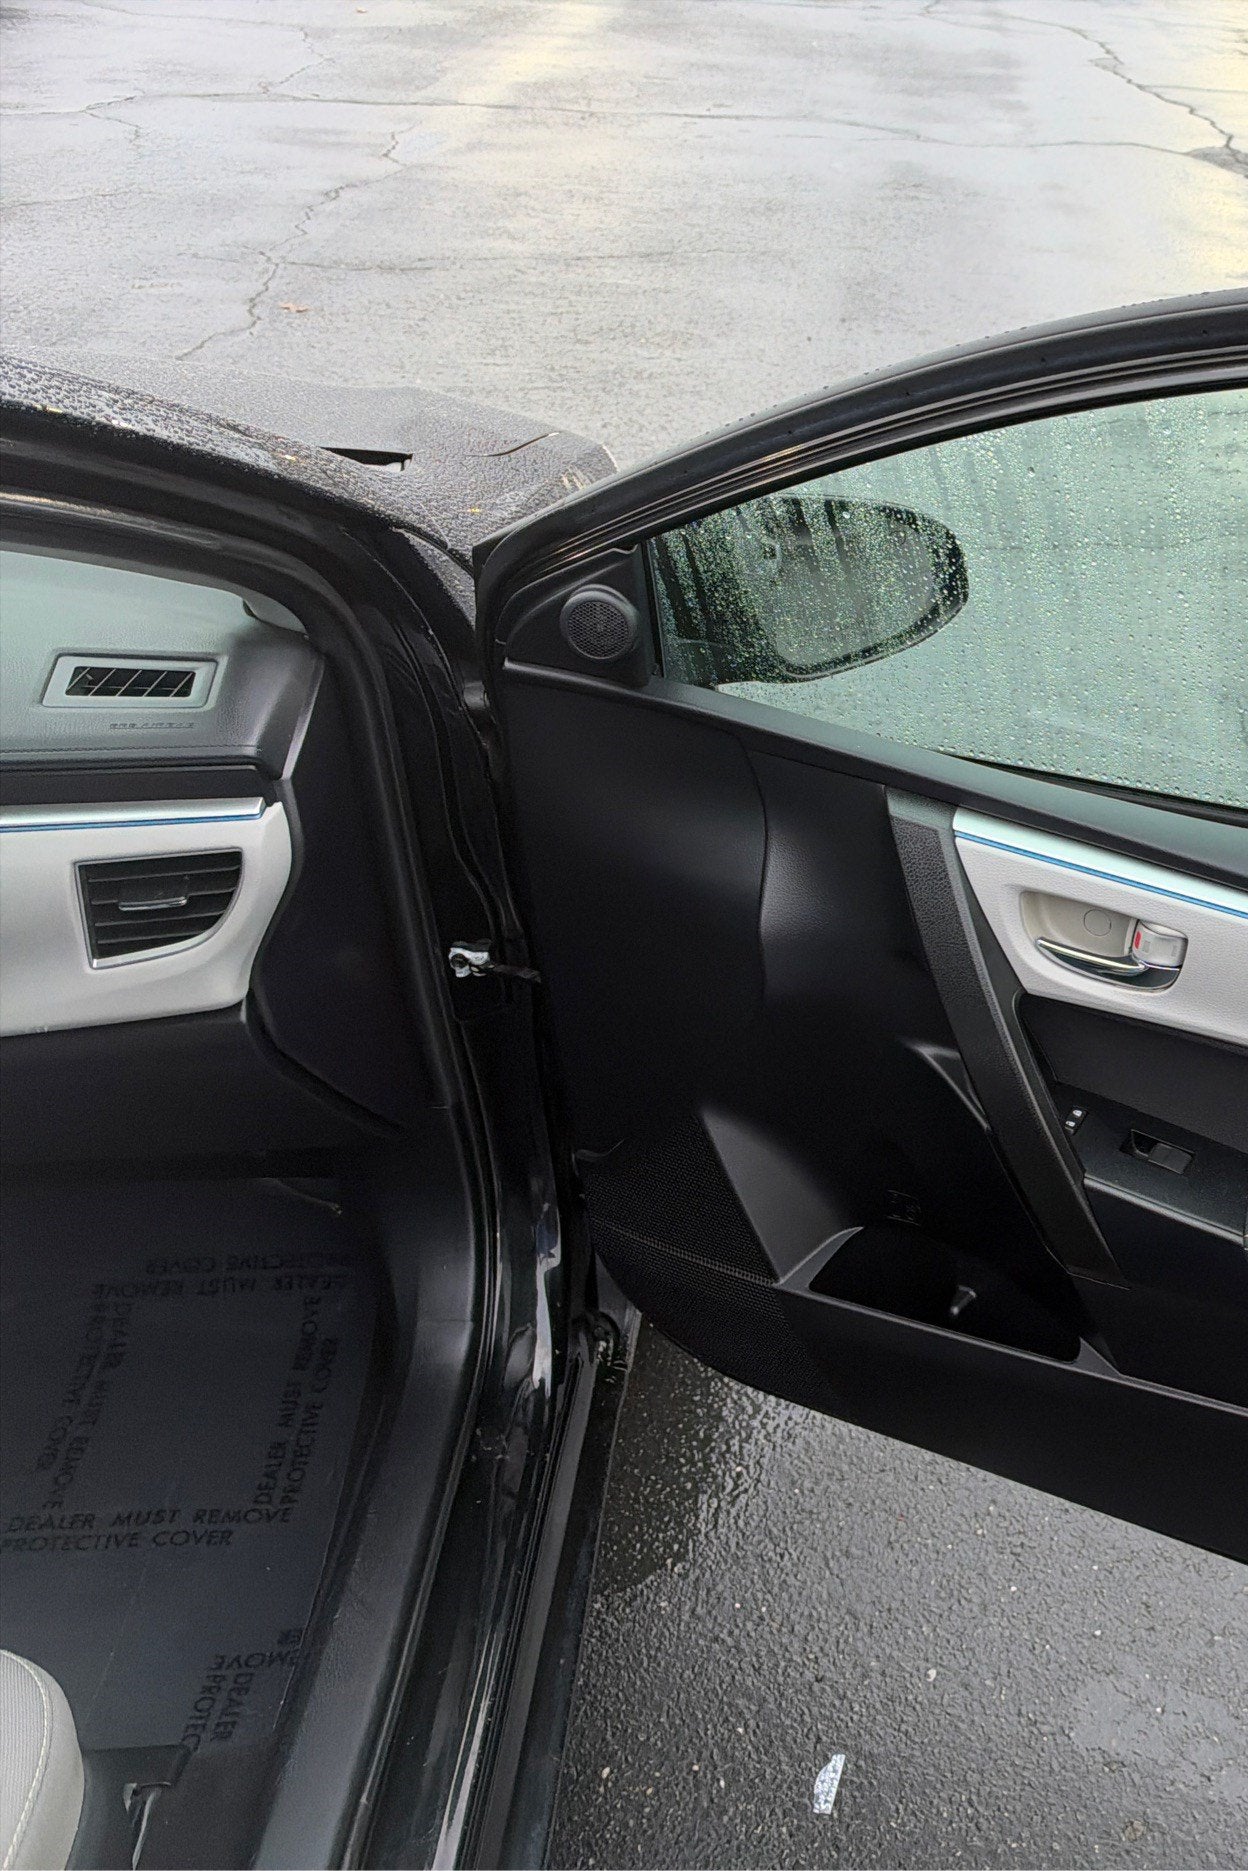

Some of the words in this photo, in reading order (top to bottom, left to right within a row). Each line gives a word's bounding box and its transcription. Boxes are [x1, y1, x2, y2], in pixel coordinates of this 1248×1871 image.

[254, 1441, 286, 1504] DEALER
[276, 1381, 302, 1427] MUST
[280, 1402, 323, 1503] PROTECTIVE
[0, 1532, 140, 1552] PROTECTIVE
[152, 1529, 234, 1547] COVER
[6, 1513, 96, 1533] DEALER
[109, 1508, 181, 1526] MUST
[192, 1507, 294, 1525] REMOVE
[210, 1672, 254, 1742] DEALER
